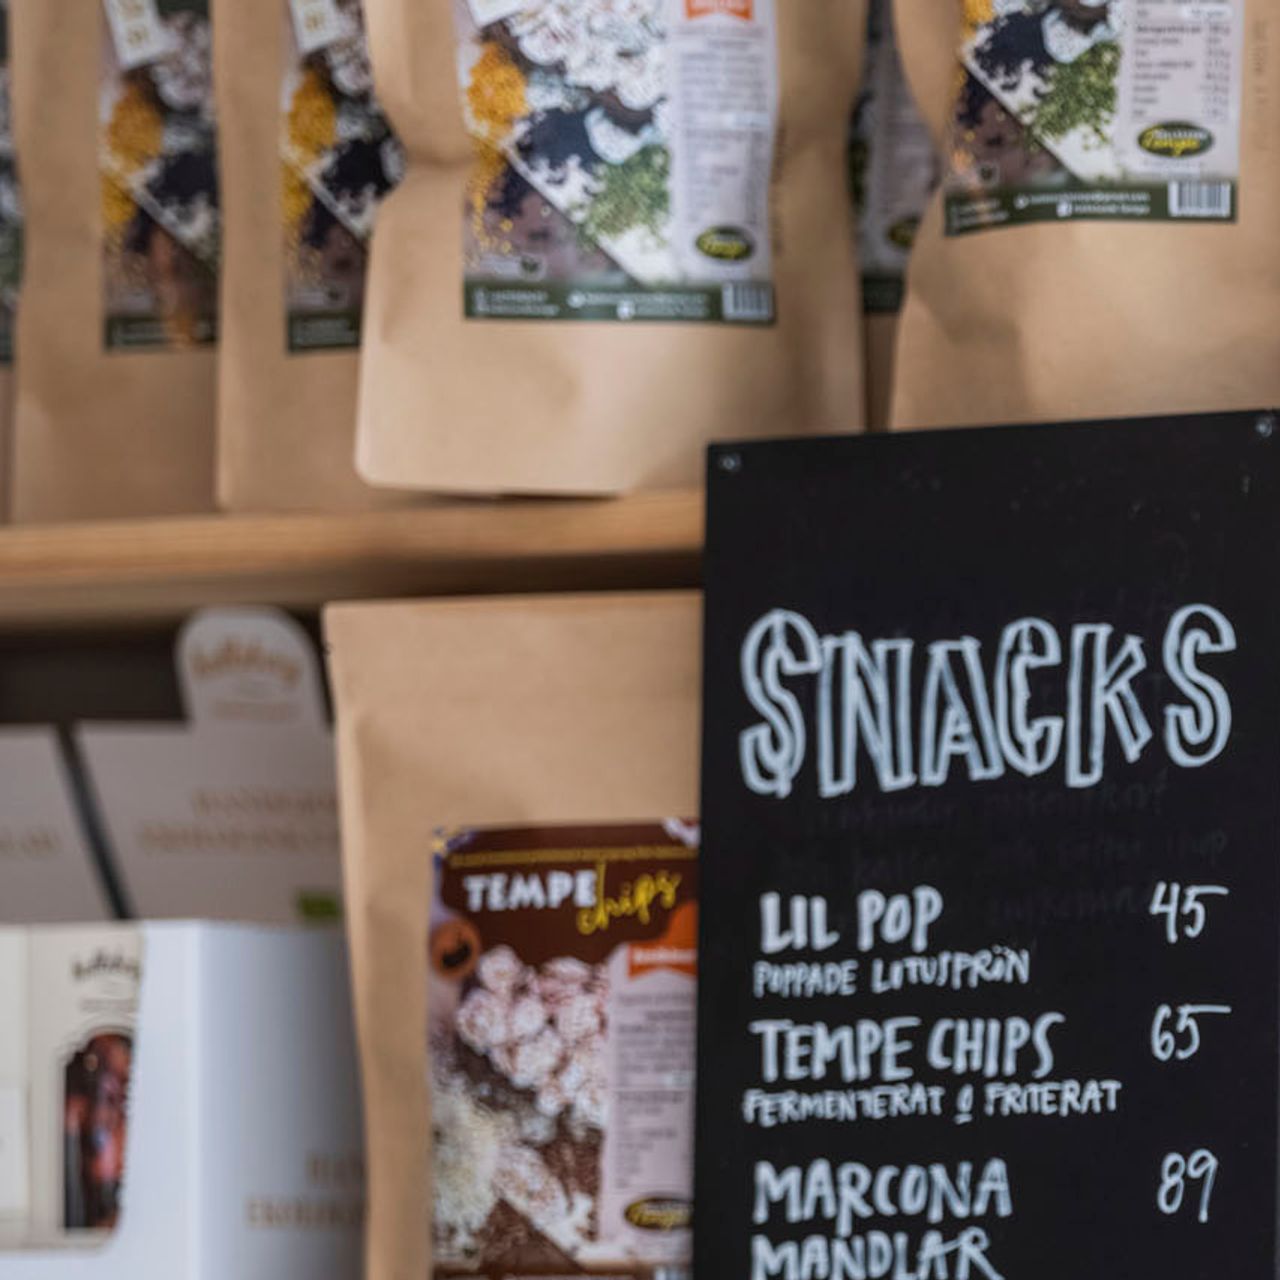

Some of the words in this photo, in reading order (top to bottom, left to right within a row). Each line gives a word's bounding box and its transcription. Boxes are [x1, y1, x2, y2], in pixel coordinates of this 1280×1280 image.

[739, 602, 1237, 798] SNACKS
[463, 869, 598, 912] TEMPE
[760, 892, 840, 953] LIL
[857, 886, 944, 953] POP
[1149, 882, 1229, 943] 45
[749, 1015, 921, 1084] TEMPE
[927, 1011, 1067, 1079] CHIPS
[1150, 1004, 1232, 1062] 65
[742, 1082, 946, 1128] FERMENTERAT
[983, 1080, 1122, 1117] FRITERAT
[751, 1157, 1014, 1238] MARCONA
[1157, 1149, 1218, 1224] 89
